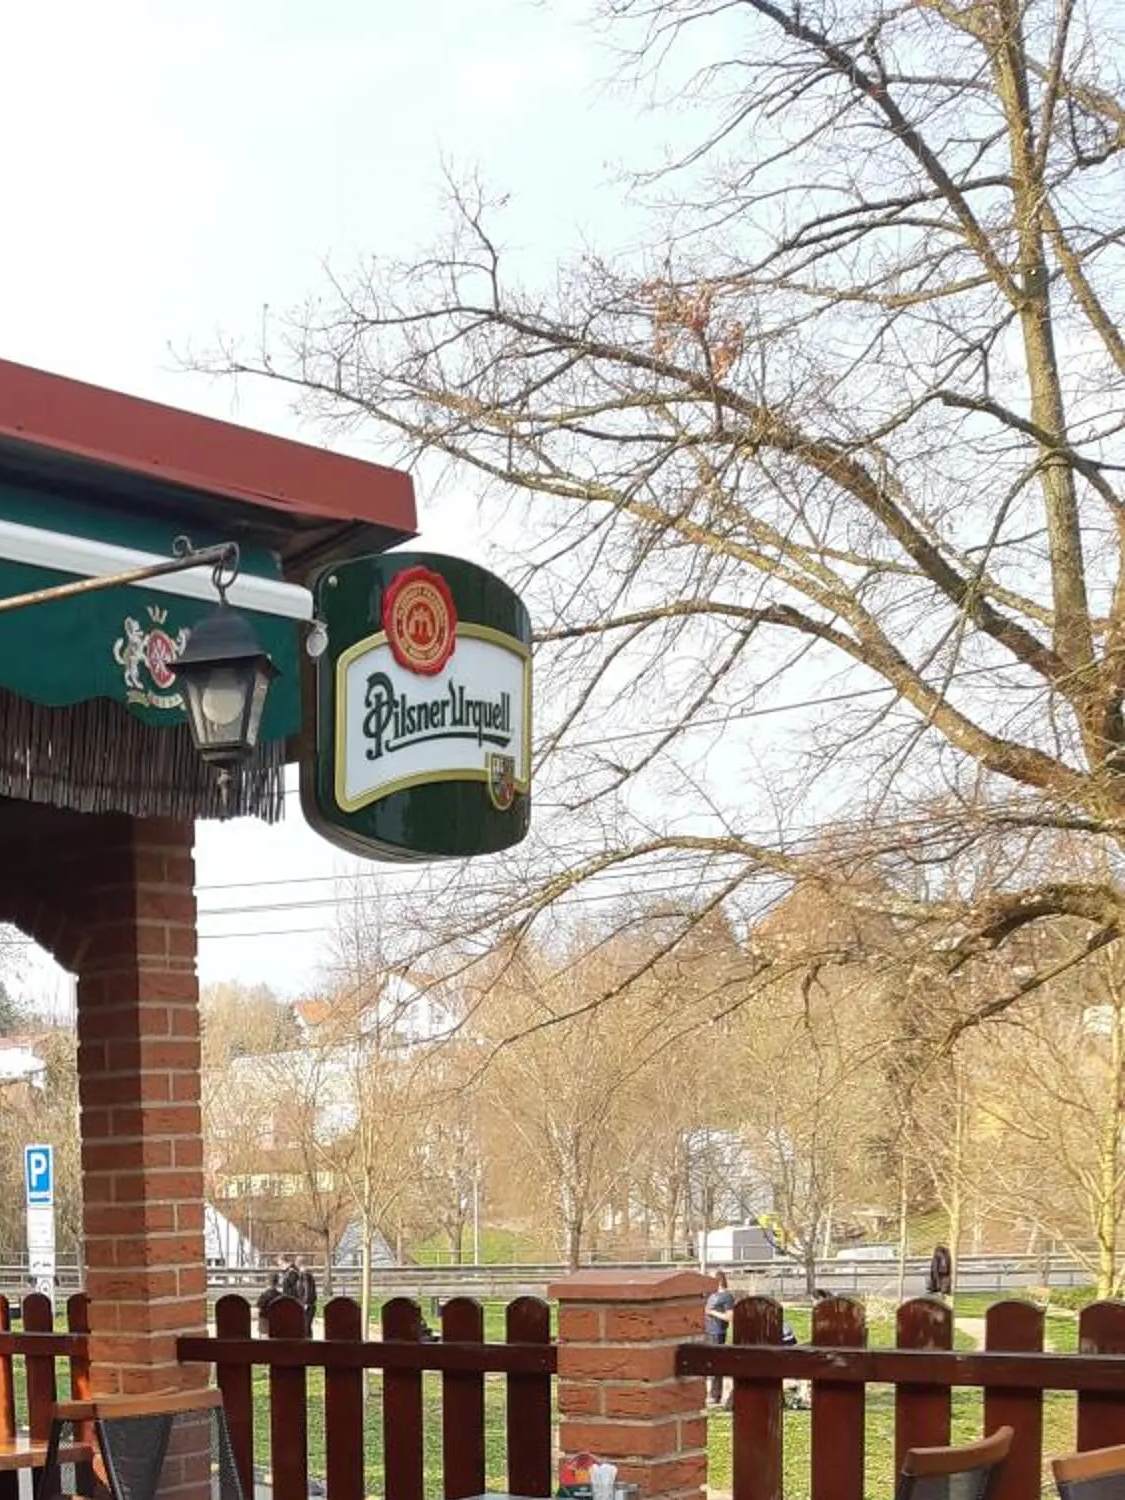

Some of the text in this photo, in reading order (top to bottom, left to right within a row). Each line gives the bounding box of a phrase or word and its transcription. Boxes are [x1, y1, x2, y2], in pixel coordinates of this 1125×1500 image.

[363, 672, 511, 760] Pilsner Urquell
[30, 1152, 47, 1188] P
